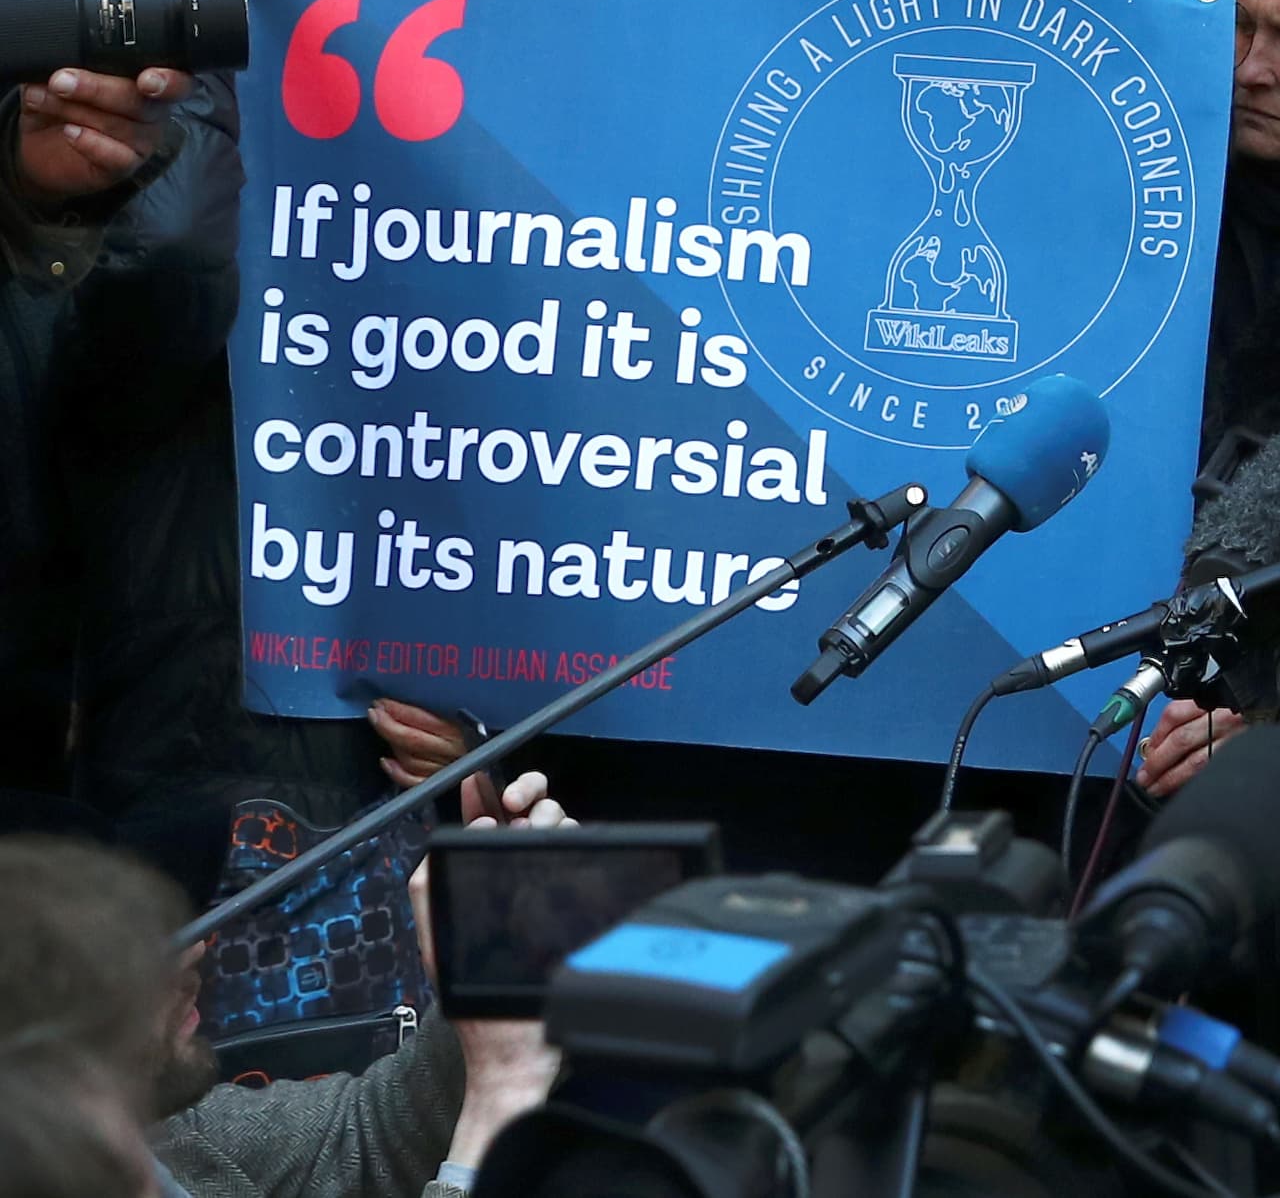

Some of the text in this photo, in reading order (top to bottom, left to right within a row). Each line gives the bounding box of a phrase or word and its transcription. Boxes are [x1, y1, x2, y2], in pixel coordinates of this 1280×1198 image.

[721, 68, 802, 225] SHINING
[799, 37, 833, 73] A
[1111, 76, 1184, 259] CORNERS
[270, 182, 812, 287] If journalism
[259, 287, 748, 390] is good it is
[875, 318, 1009, 355] WikiLeaks
[803, 356, 929, 429] SINCE
[252, 410, 828, 506] controversial
[249, 502, 801, 612] by its nature
[250, 632, 369, 671] WIKILEAKS
[376, 642, 459, 677] EDITOR
[466, 650, 548, 682] JULIAN
